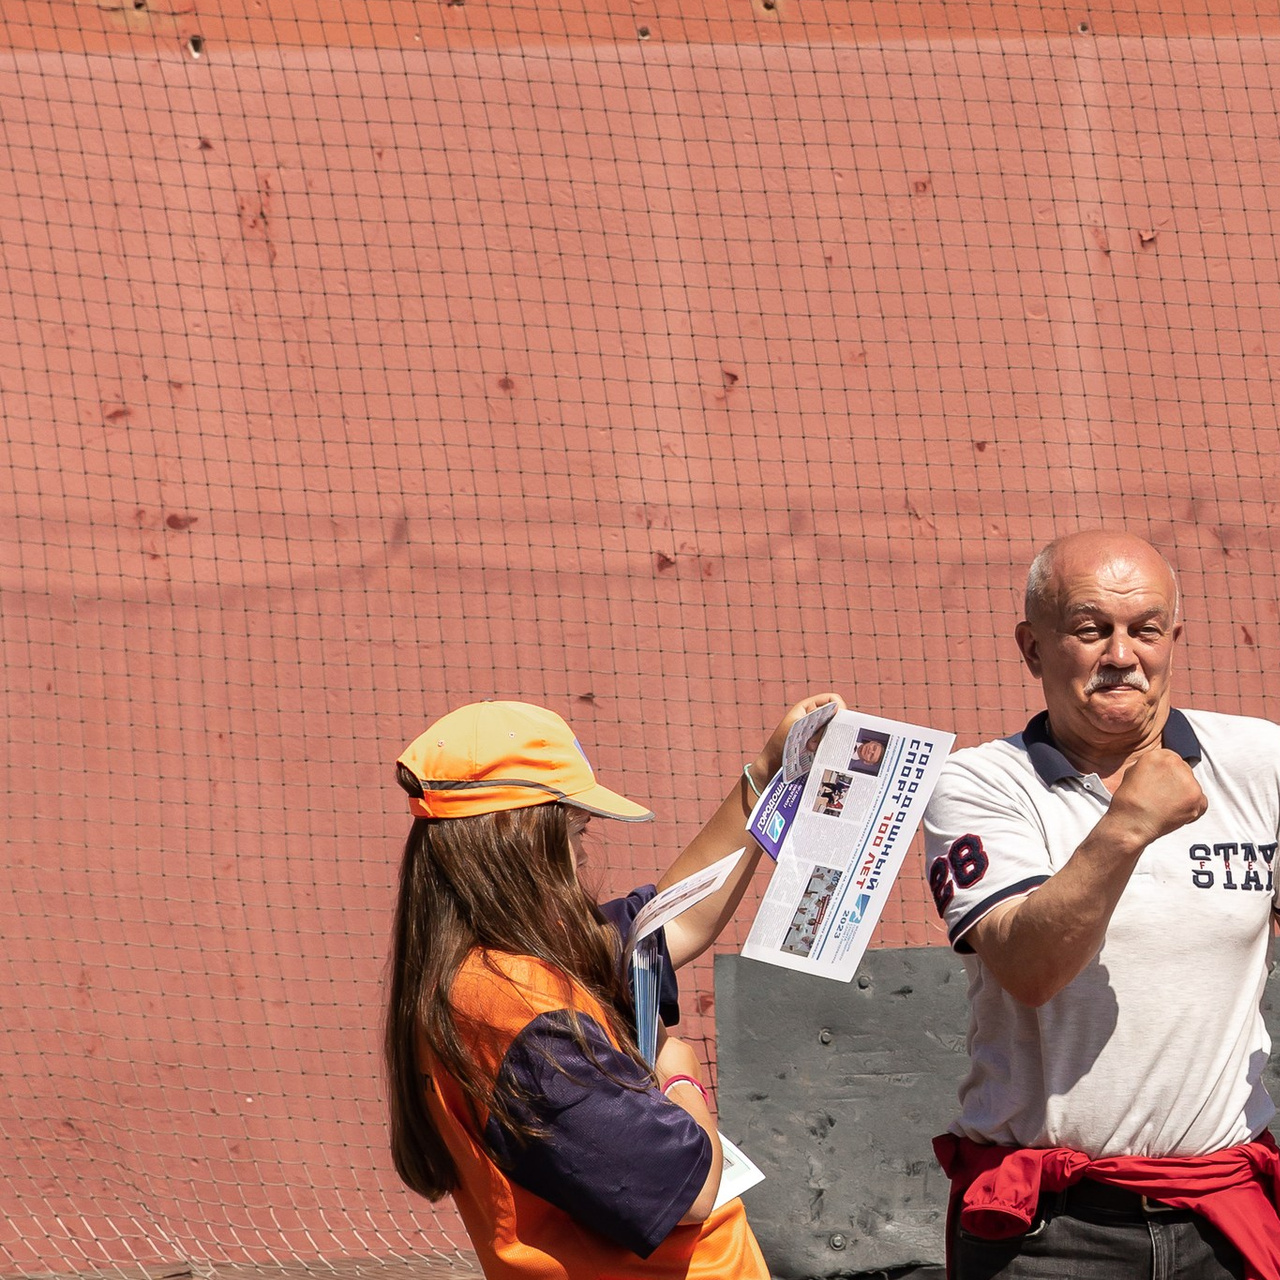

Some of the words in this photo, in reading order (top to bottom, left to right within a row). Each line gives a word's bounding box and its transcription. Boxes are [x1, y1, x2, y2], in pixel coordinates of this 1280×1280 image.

[892, 739, 921, 804] СПОРТ
[866, 742, 934, 891] ГОРОДОШНЫЙ
[873, 812, 894, 847] 100
[856, 852, 876, 890] ЛЕТ
[929, 833, 989, 919] 28
[1189, 842, 1278, 892] STAY
[834, 910, 850, 939] 2023
